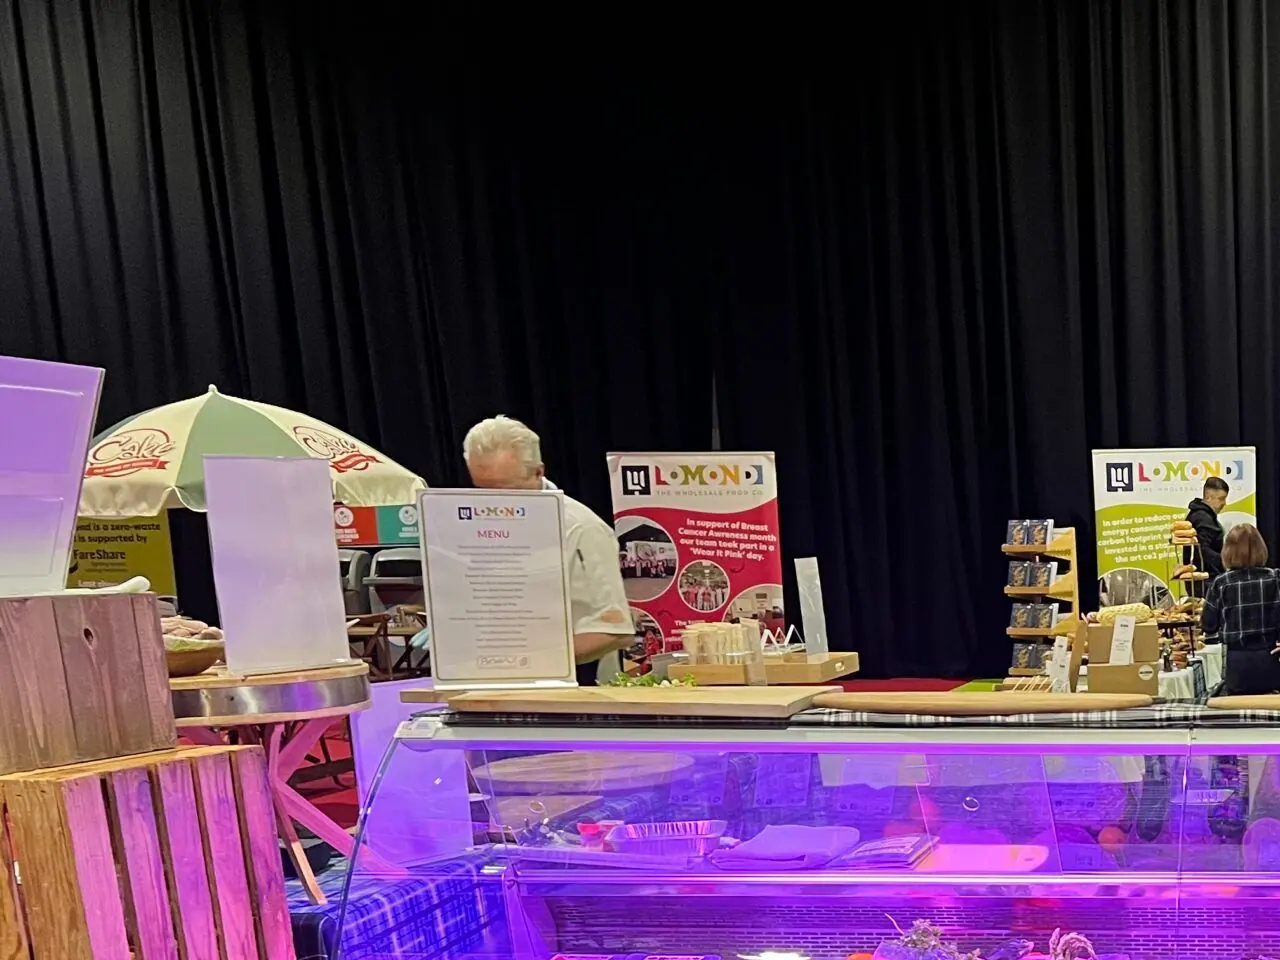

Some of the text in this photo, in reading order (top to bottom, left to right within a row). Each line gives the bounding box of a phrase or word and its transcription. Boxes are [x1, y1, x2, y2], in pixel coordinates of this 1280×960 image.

[655, 465, 764, 486] LOMOND
[1138, 460, 1244, 482] LOMOND
[687, 518, 695, 526] In
[696, 520, 729, 528] support
[741, 523, 768, 531] Breast
[1112, 518, 1133, 526] order
[1144, 513, 1171, 522] reduce
[93, 522, 100, 531] is
[110, 522, 161, 531] zero-waste
[678, 527, 707, 536] Cancer
[477, 530, 510, 538] MENU
[1102, 528, 1129, 537] energy
[78, 533, 147, 544] is supported by
[1097, 538, 1125, 546] carbon
[1126, 533, 1162, 543] footprint
[695, 538, 717, 547] team
[718, 540, 738, 548] took
[739, 542, 758, 551] part
[1104, 545, 1138, 555] invested
[73, 549, 126, 560] FareShare
[1115, 555, 1128, 563] the
[1129, 554, 1142, 562] art
